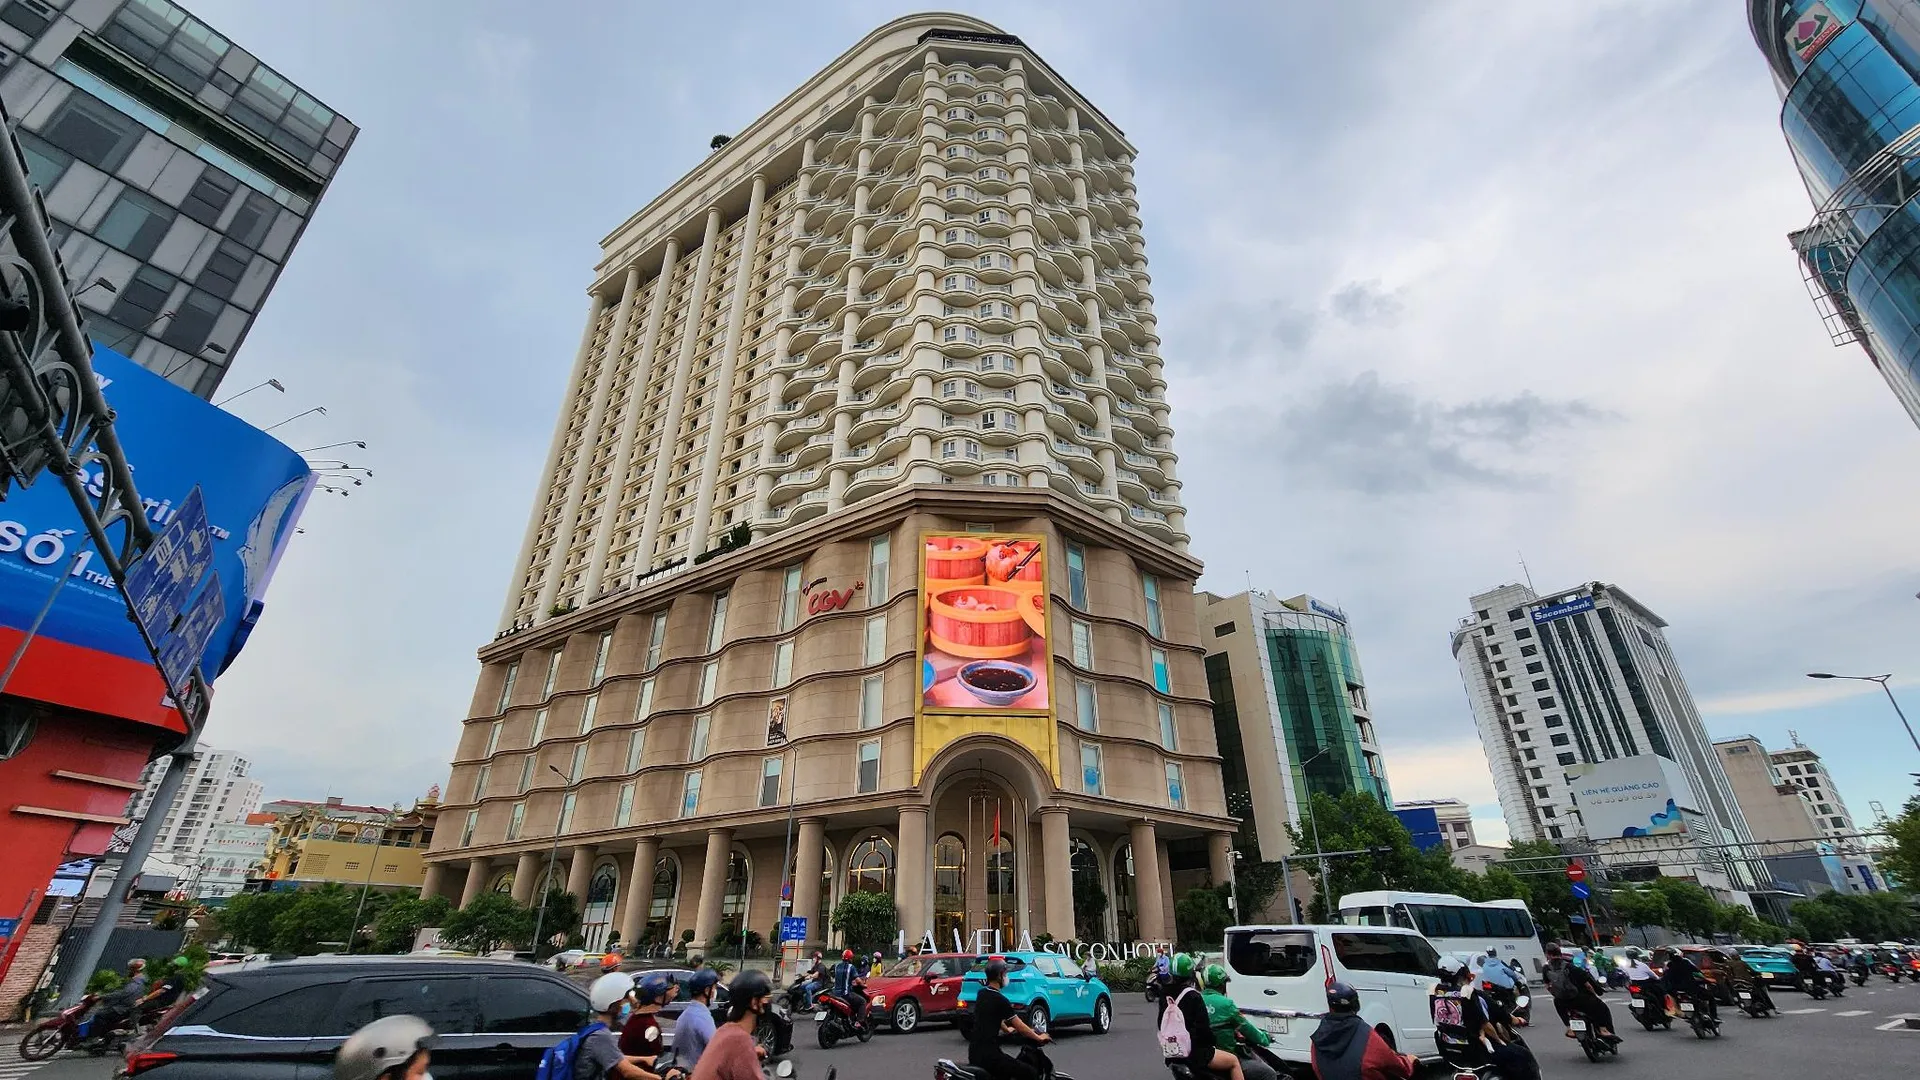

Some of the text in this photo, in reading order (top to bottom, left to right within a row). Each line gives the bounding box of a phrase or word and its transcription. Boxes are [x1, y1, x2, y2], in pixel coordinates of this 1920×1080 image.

[71, 550, 94, 577] 1
[808, 588, 854, 614] CGV
[1534, 600, 1591, 620] Sacombank
[898, 929, 938, 955] LA
